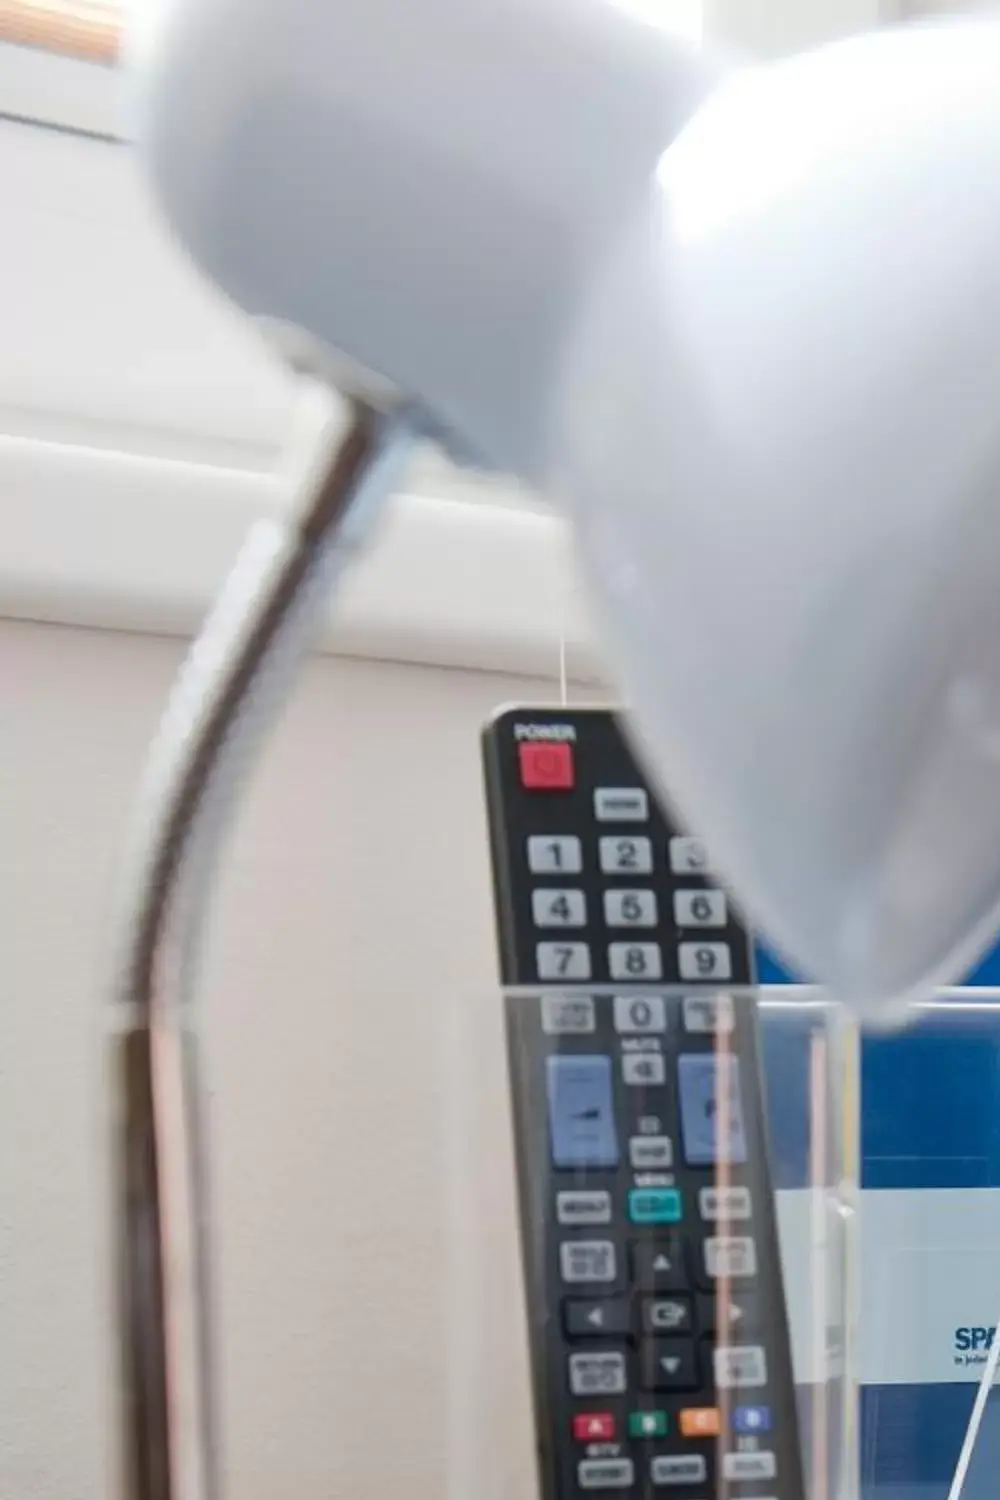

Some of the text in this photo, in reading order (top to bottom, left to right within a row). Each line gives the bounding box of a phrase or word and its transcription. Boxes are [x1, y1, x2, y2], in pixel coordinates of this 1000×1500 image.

[548, 843, 563, 867] 1
[616, 842, 638, 868] 2
[550, 895, 712, 921] 4 5 6
[553, 948, 716, 974] 7 8 9
[629, 1002, 650, 1026] 0
[588, 1418, 605, 1435] A
